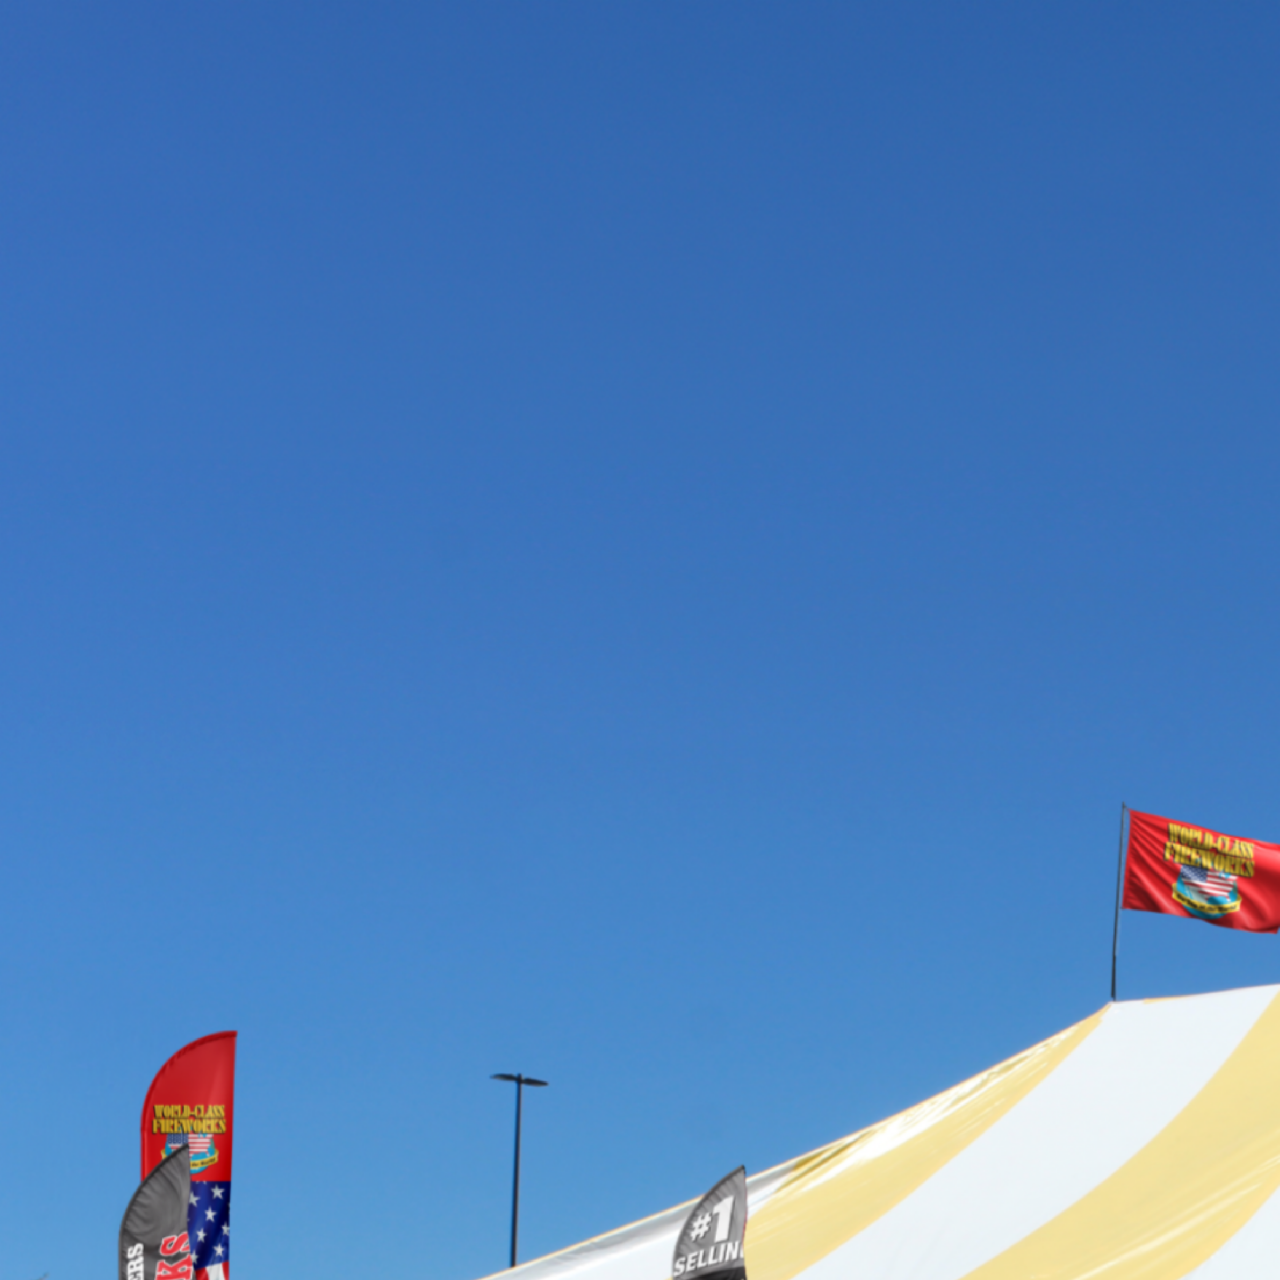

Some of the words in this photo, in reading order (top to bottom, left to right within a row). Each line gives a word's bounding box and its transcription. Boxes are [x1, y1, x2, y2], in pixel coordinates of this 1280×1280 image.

[1164, 841, 1254, 878] FIREWORKS
[153, 1104, 225, 1119] WORLD-CLASS
[152, 1119, 226, 1134] FIREWORKS
[690, 1195, 734, 1243] #1
